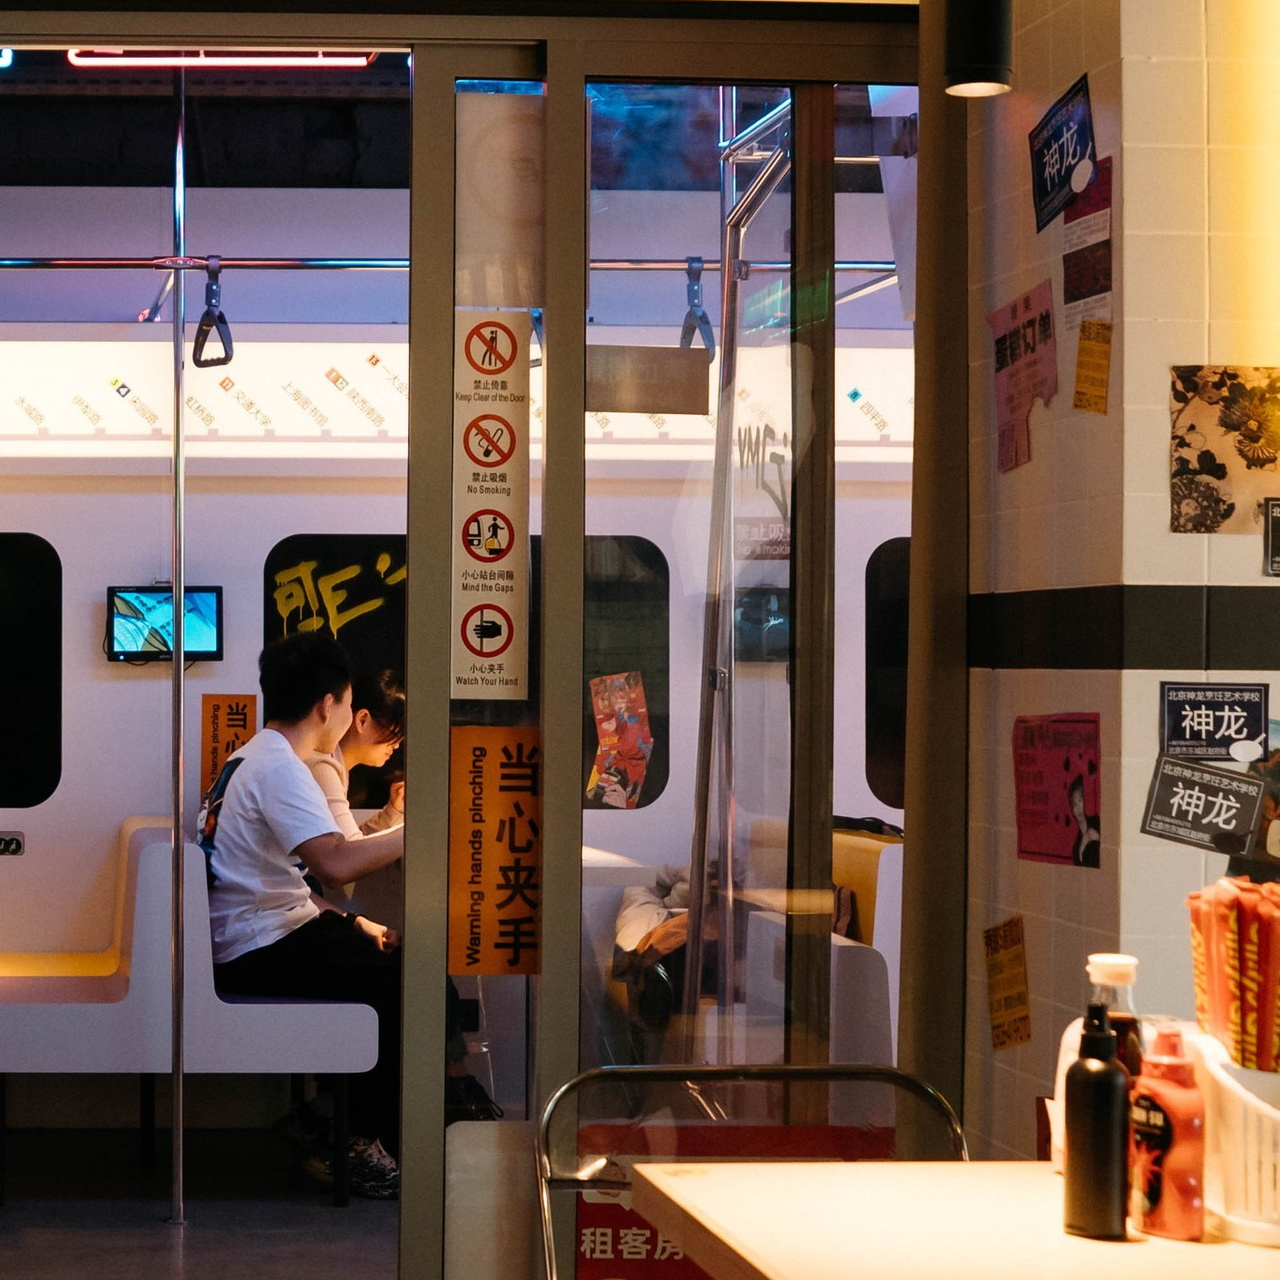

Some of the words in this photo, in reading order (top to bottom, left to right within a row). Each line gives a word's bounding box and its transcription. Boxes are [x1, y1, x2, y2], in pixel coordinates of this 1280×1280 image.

[1043, 122, 1081, 192] 神龙
[232, 391, 272, 428] 交通大学
[455, 392, 472, 403] Keep
[473, 392, 491, 402] Clear
[499, 392, 509, 402] the
[510, 392, 525, 403] Door
[859, 401, 890, 432] 四平路
[467, 485, 476, 494] No
[477, 485, 511, 497] Smoking
[471, 472, 507, 483] 禁止吸烟
[461, 582, 479, 592] Mind
[480, 583, 492, 592] the
[494, 583, 514, 594] Gaps
[455, 676, 478, 686] Watch
[479, 676, 495, 686] Your
[496, 676, 518, 686] Hand
[469, 663, 505, 674] 小心夹手
[210, 704, 221, 744] pinching
[1181, 705, 1248, 740] 神龙
[470, 745, 488, 825] pinching
[1170, 782, 1241, 831] 神龙
[467, 836, 483, 887] hands
[494, 742, 540, 967] 当心夹手
[465, 890, 484, 967] Warning
[581, 1227, 685, 1261] 租客房
